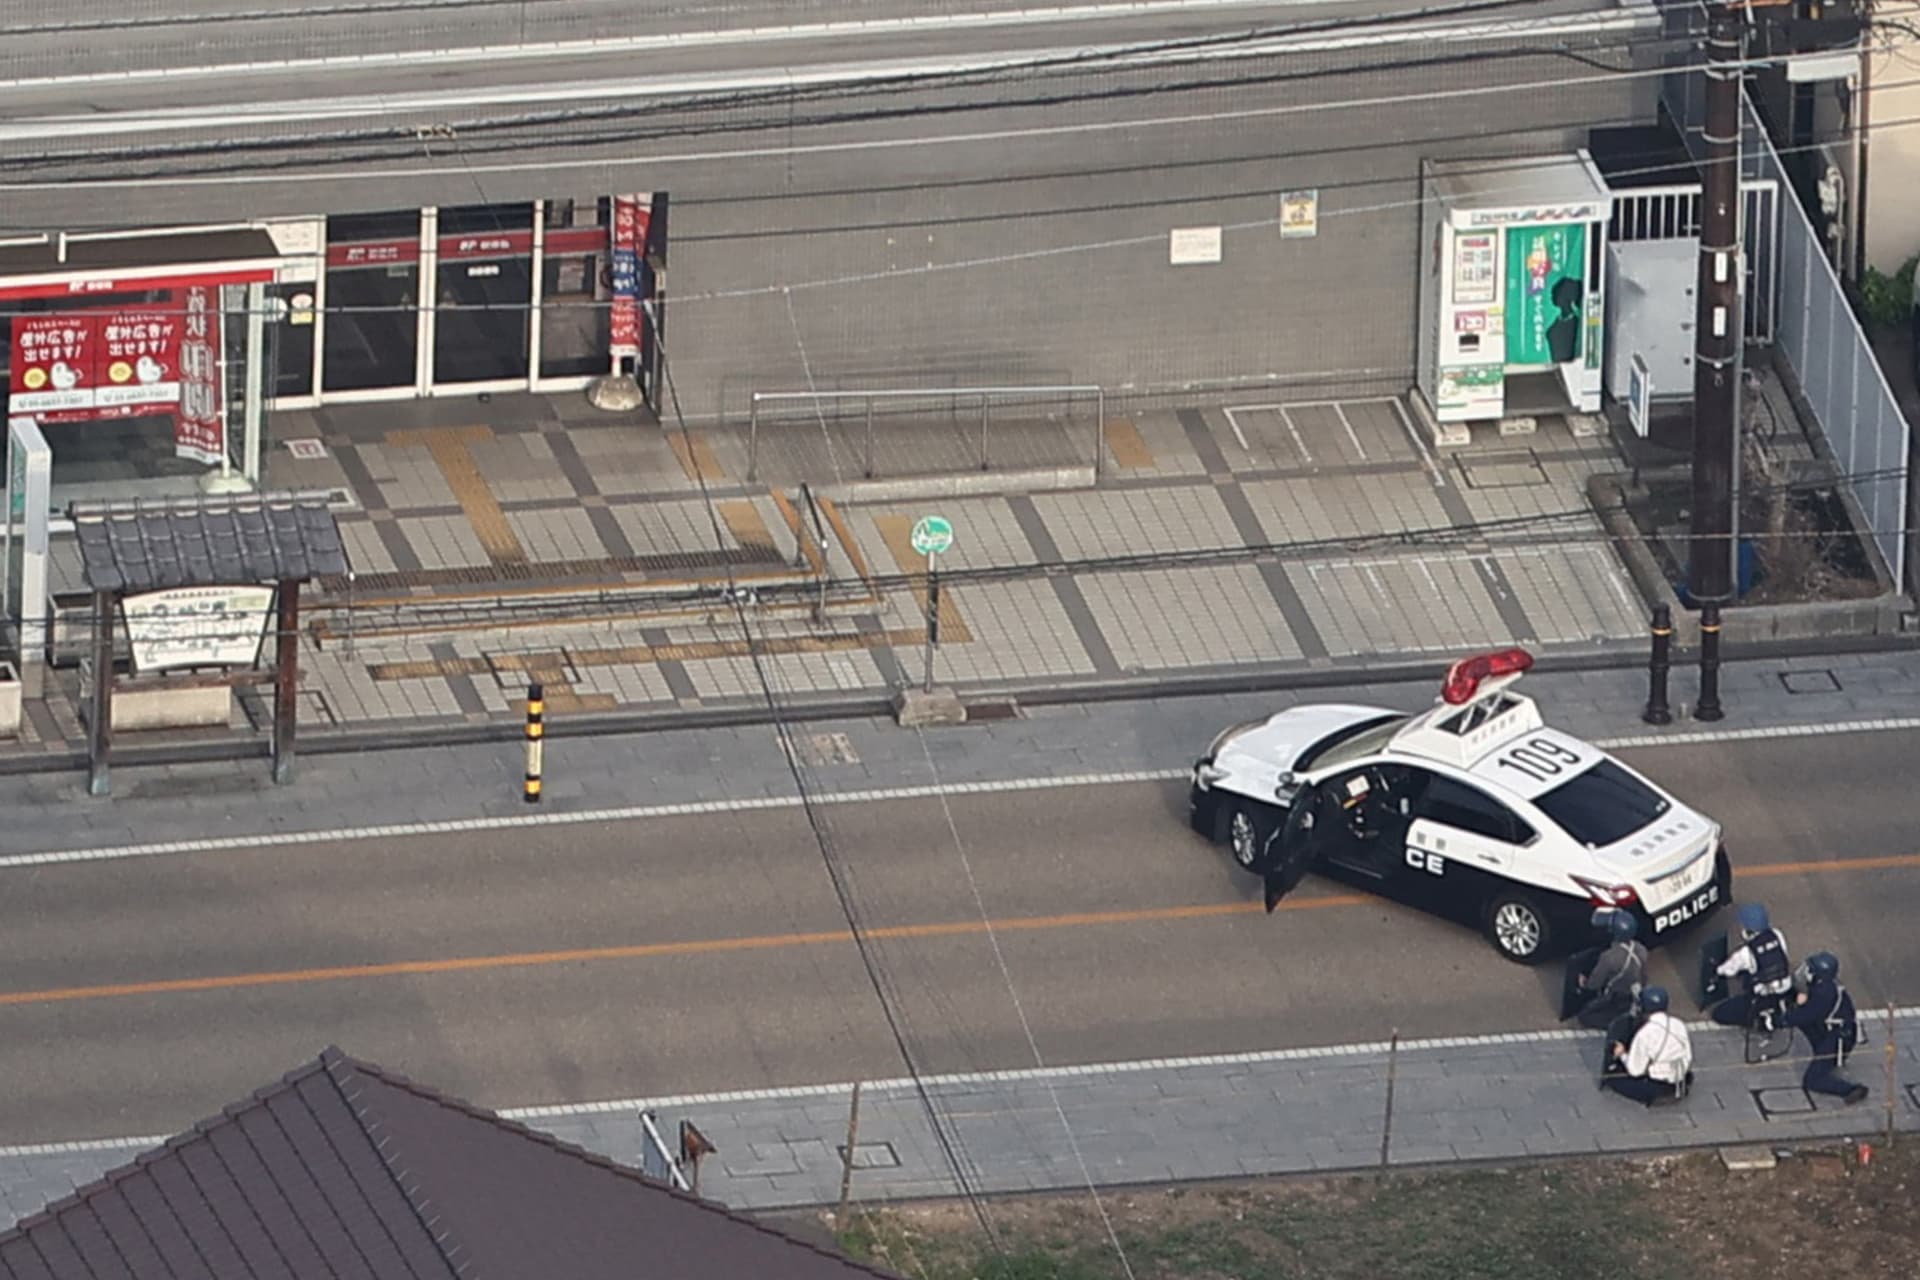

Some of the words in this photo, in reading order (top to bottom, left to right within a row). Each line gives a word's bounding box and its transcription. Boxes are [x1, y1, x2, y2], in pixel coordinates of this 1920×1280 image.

[1498, 738, 1582, 783] 109
[1406, 848, 1444, 875] CE
[1655, 885, 1719, 934] POLICE
